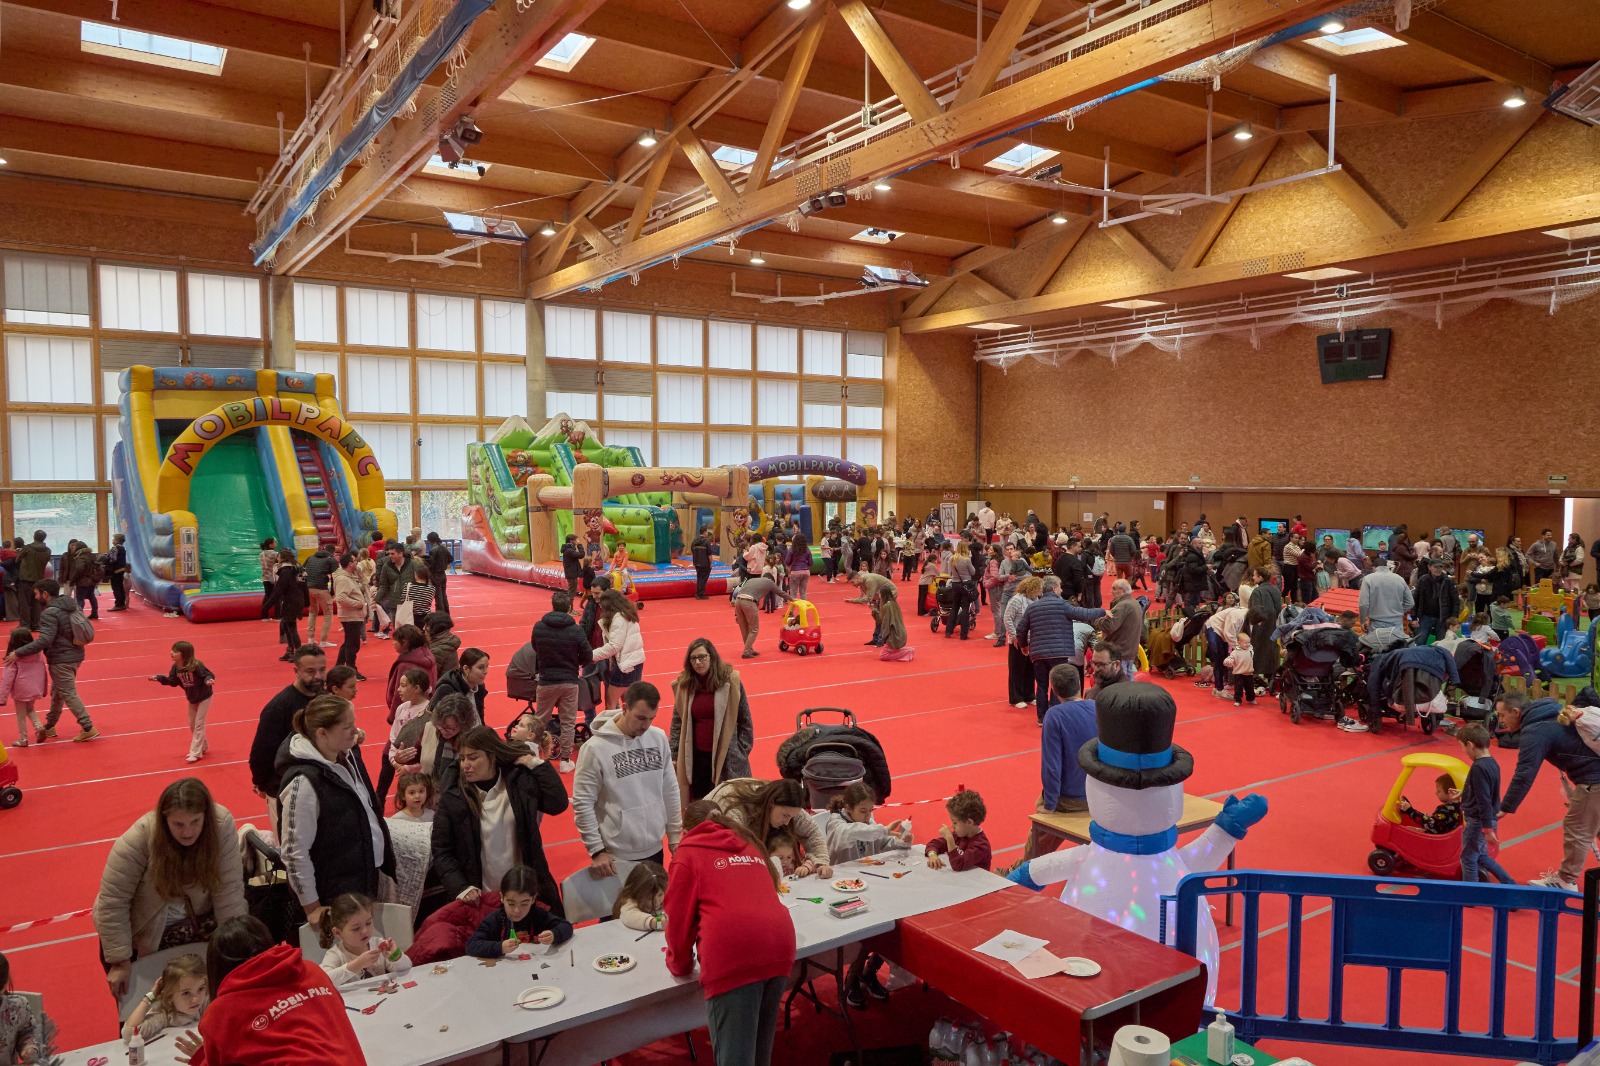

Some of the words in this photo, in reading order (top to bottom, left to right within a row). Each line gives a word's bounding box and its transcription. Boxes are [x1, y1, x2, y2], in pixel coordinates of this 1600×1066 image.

[167, 397, 381, 477] MOBILPARC
[767, 460, 841, 475] MOBILPARC
[269, 992, 309, 1018] MÒBIL
[307, 986, 333, 999] PARC
